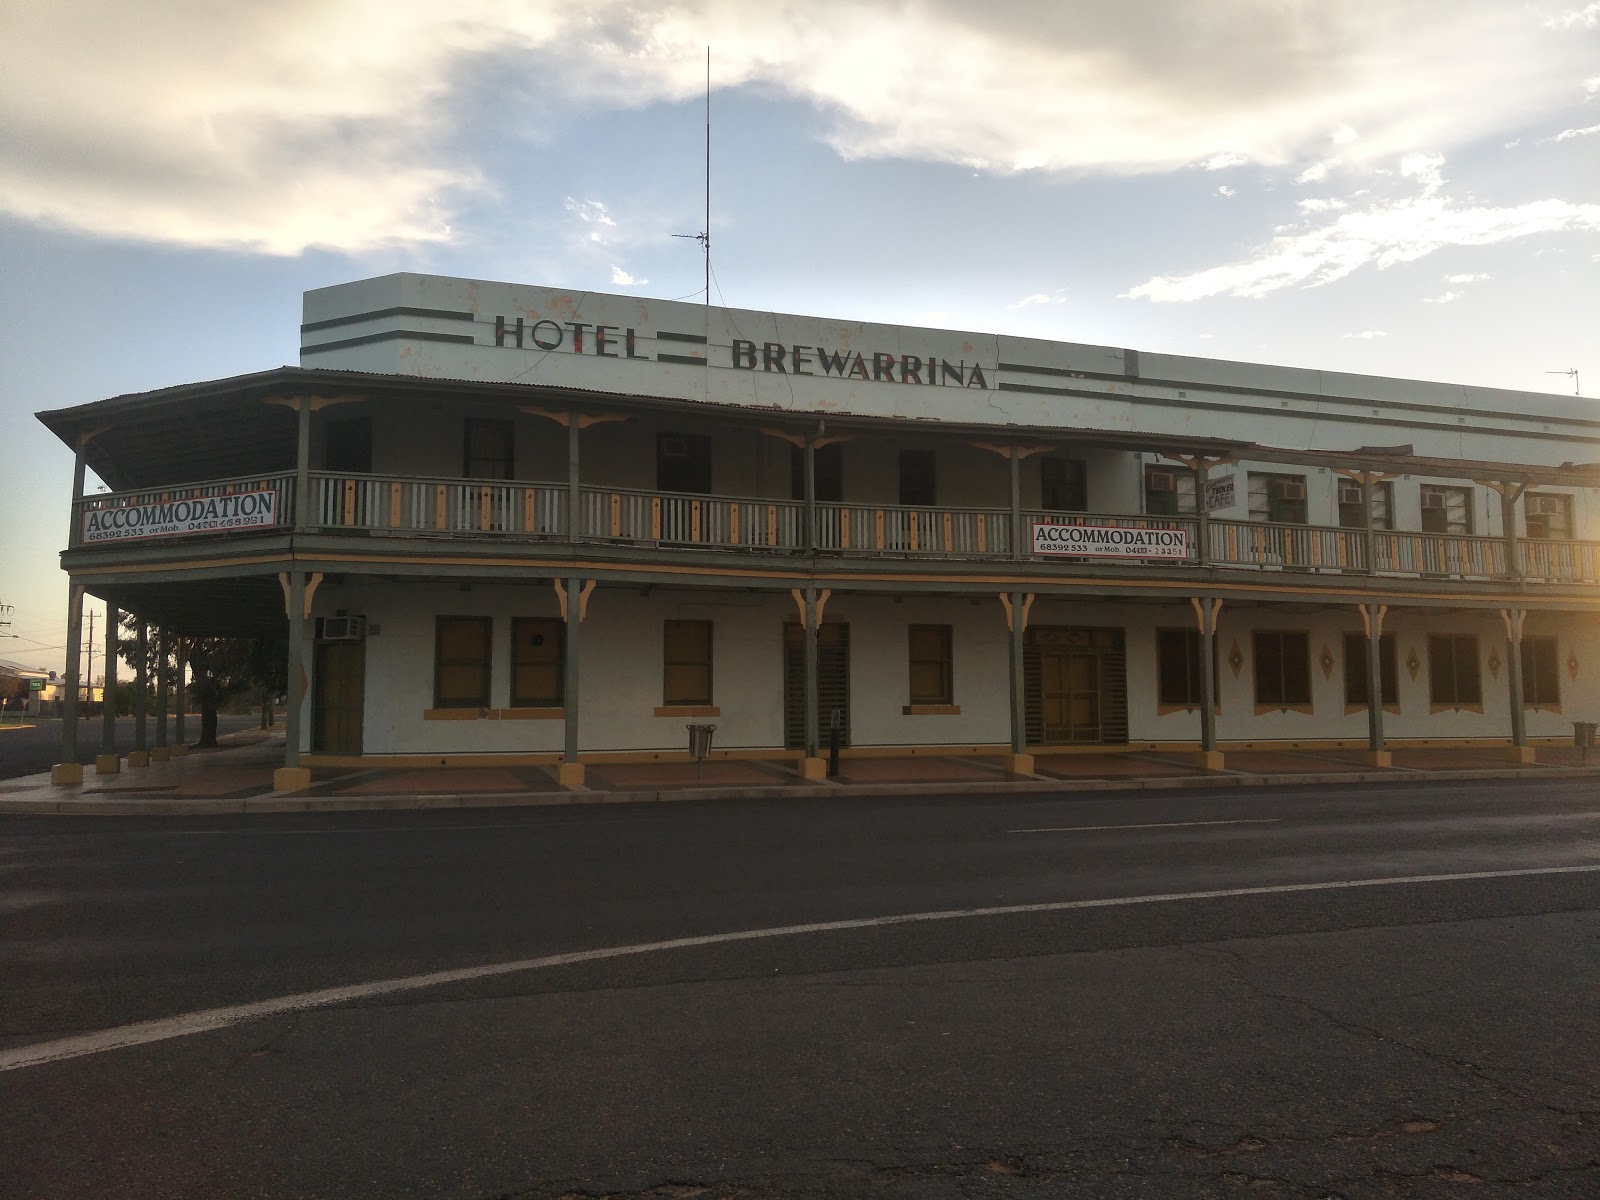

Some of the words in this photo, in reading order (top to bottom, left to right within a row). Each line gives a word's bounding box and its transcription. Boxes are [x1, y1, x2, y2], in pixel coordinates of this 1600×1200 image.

[495, 315, 649, 359] HOTEL
[732, 339, 988, 389] BREWARRINA
[1209, 492, 1231, 509] CAFE
[88, 492, 273, 531] ACCOMMODATION
[123, 528, 144, 537] 533
[160, 525, 180, 533] Mob.
[1035, 527, 1183, 547] ACCOMMODATION
[1040, 543, 1069, 551] 68392
[1071, 544, 1088, 552] 533
